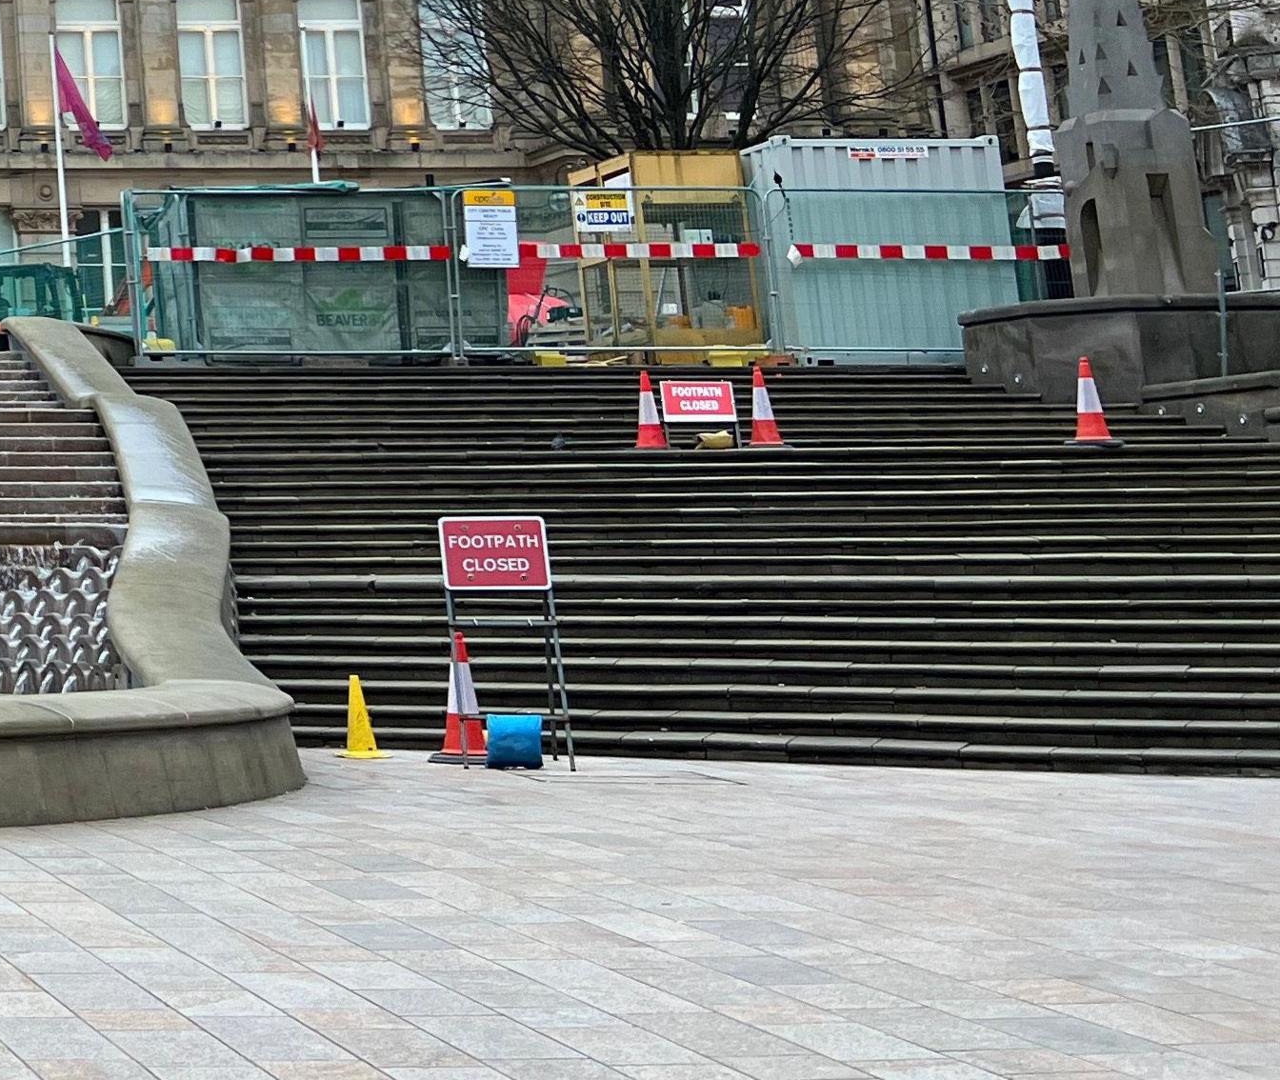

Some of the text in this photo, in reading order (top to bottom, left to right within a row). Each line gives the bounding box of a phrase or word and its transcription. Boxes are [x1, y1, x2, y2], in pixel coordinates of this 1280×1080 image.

[588, 212, 628, 223] KEEP OUT
[671, 386, 723, 397] FOOTPATH
[680, 400, 719, 411] CLOSED
[448, 534, 539, 549] FOOTPATH
[462, 557, 530, 572] CLOSED
